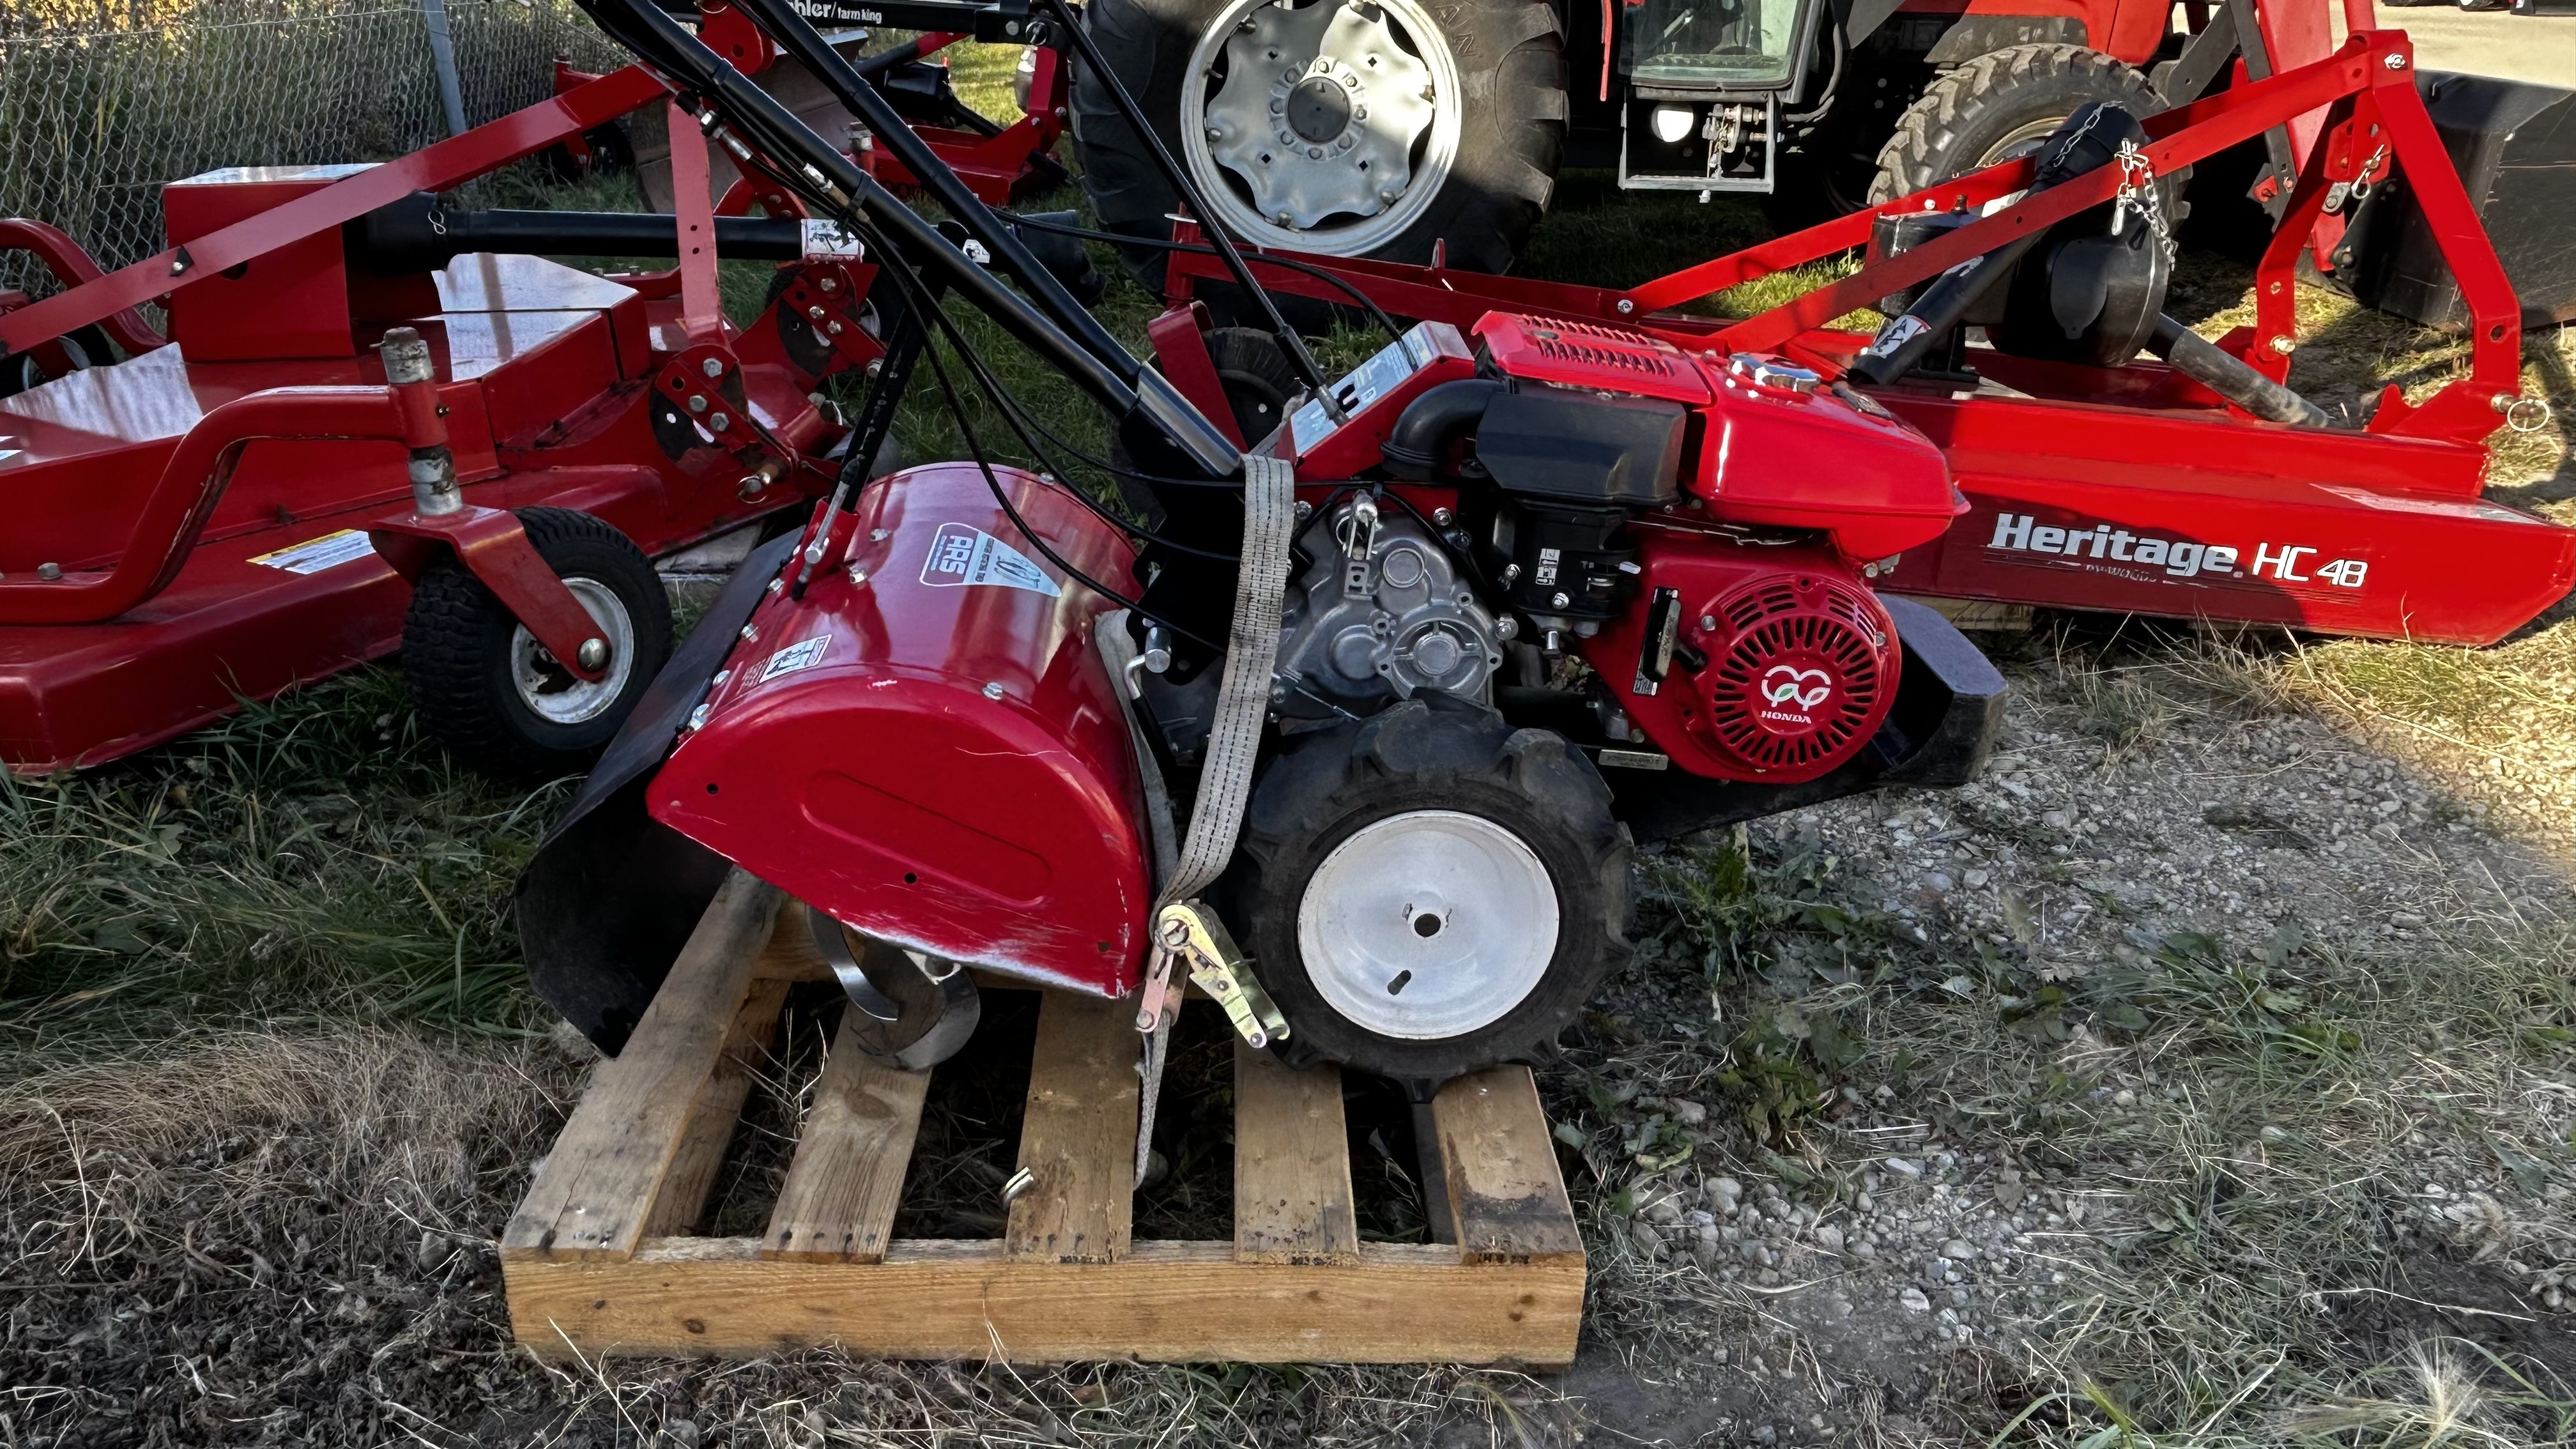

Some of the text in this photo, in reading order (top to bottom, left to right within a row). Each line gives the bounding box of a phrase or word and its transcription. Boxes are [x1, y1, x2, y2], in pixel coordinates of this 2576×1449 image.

[861, 8, 882, 24] king
[2251, 542, 2318, 582] HC
[2317, 560, 2368, 587] 48
[1761, 710, 1812, 724] HONDA
